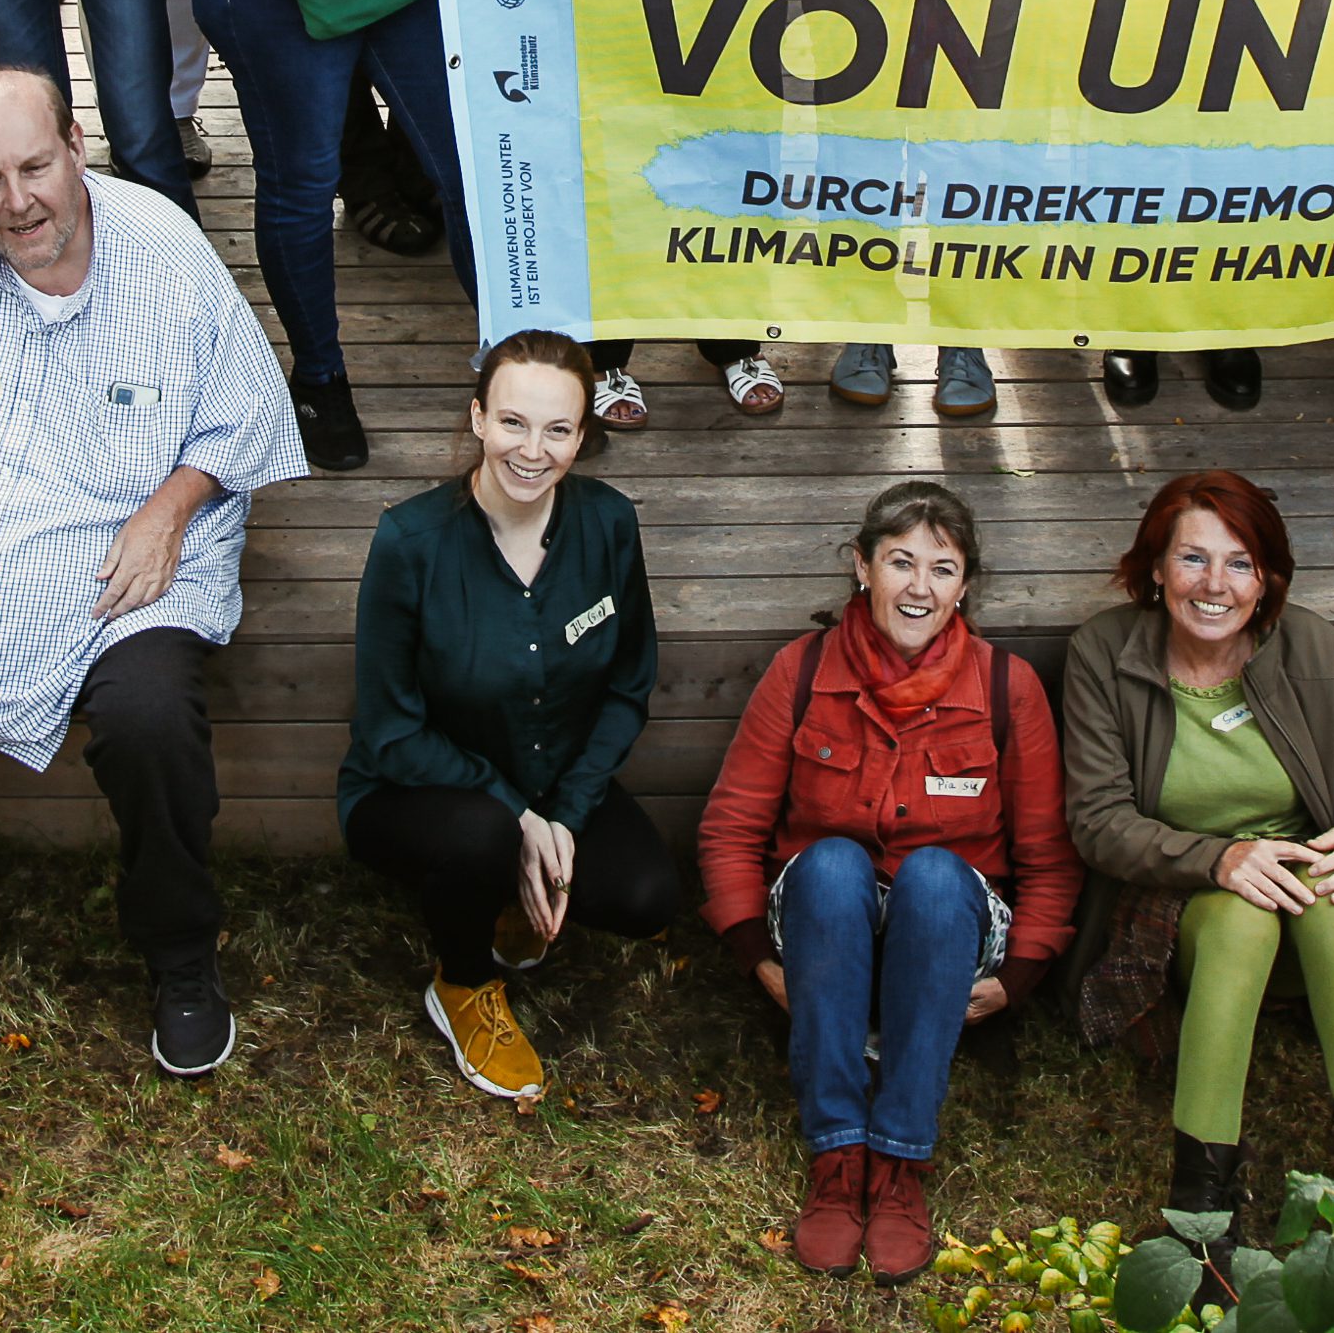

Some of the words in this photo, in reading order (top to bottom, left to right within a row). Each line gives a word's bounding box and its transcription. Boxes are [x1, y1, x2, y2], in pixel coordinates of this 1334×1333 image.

[528, 35, 540, 90] Klimaschutz
[499, 133, 513, 181] UNTEN
[520, 161, 533, 193] VON
[503, 182, 515, 214] VON
[741, 170, 928, 219] DURCH
[941, 183, 1161, 225] DIREKTE
[522, 196, 537, 258] PROJEKT
[505, 215, 523, 309] KLIMAWENDE
[526, 259, 539, 283] EIN
[665, 226, 1031, 281] KLIMAPOLITIK
[1039, 244, 1096, 282] IN
[1107, 246, 1200, 285] DIE
[529, 285, 540, 305] IST
[935, 777, 956, 790] Pia
